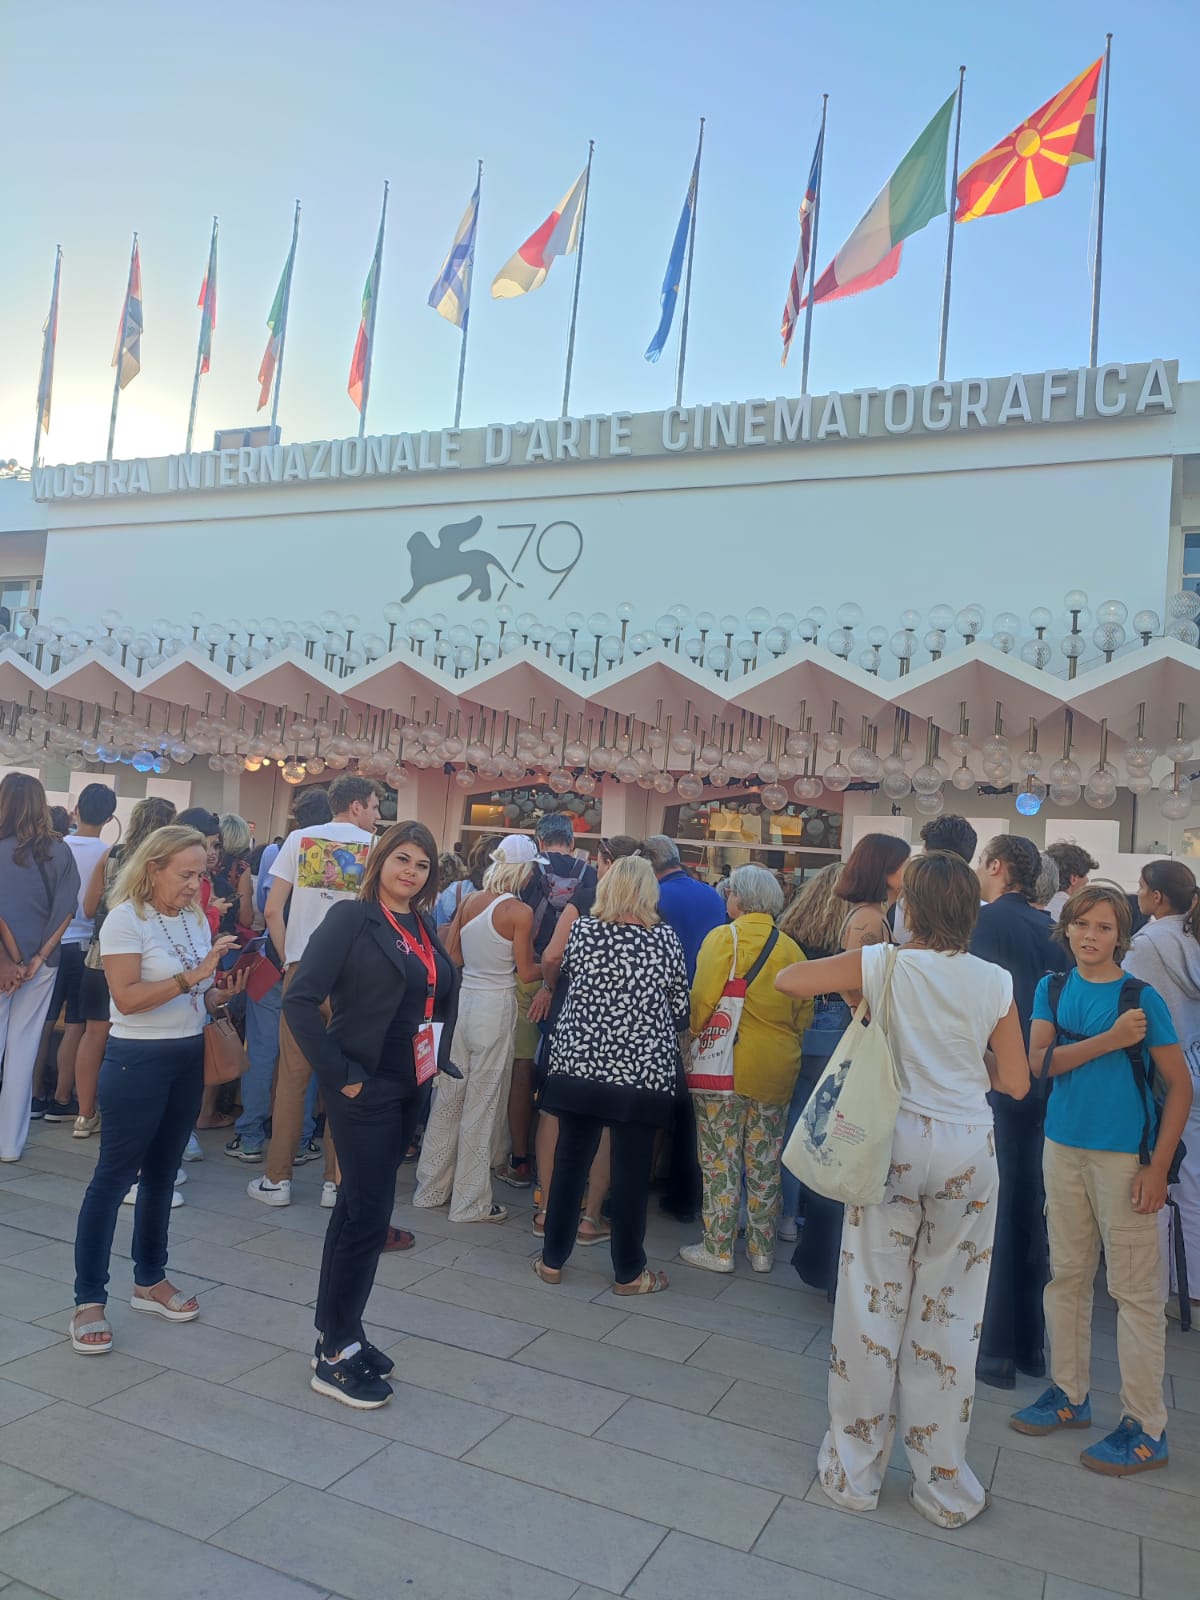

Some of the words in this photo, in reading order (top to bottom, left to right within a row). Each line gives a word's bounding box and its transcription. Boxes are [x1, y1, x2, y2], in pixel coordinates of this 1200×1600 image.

[32, 457, 150, 500] MOSTRA
[167, 427, 461, 490] INTERNAZIONALE
[484, 410, 633, 465] D'ARTE
[662, 359, 1176, 452] CINEMATOGRAFICA
[497, 520, 584, 601] 79
[699, 1025, 728, 1039] vana
[1057, 1406, 1074, 1423] N
[1133, 1443, 1153, 1461] N
